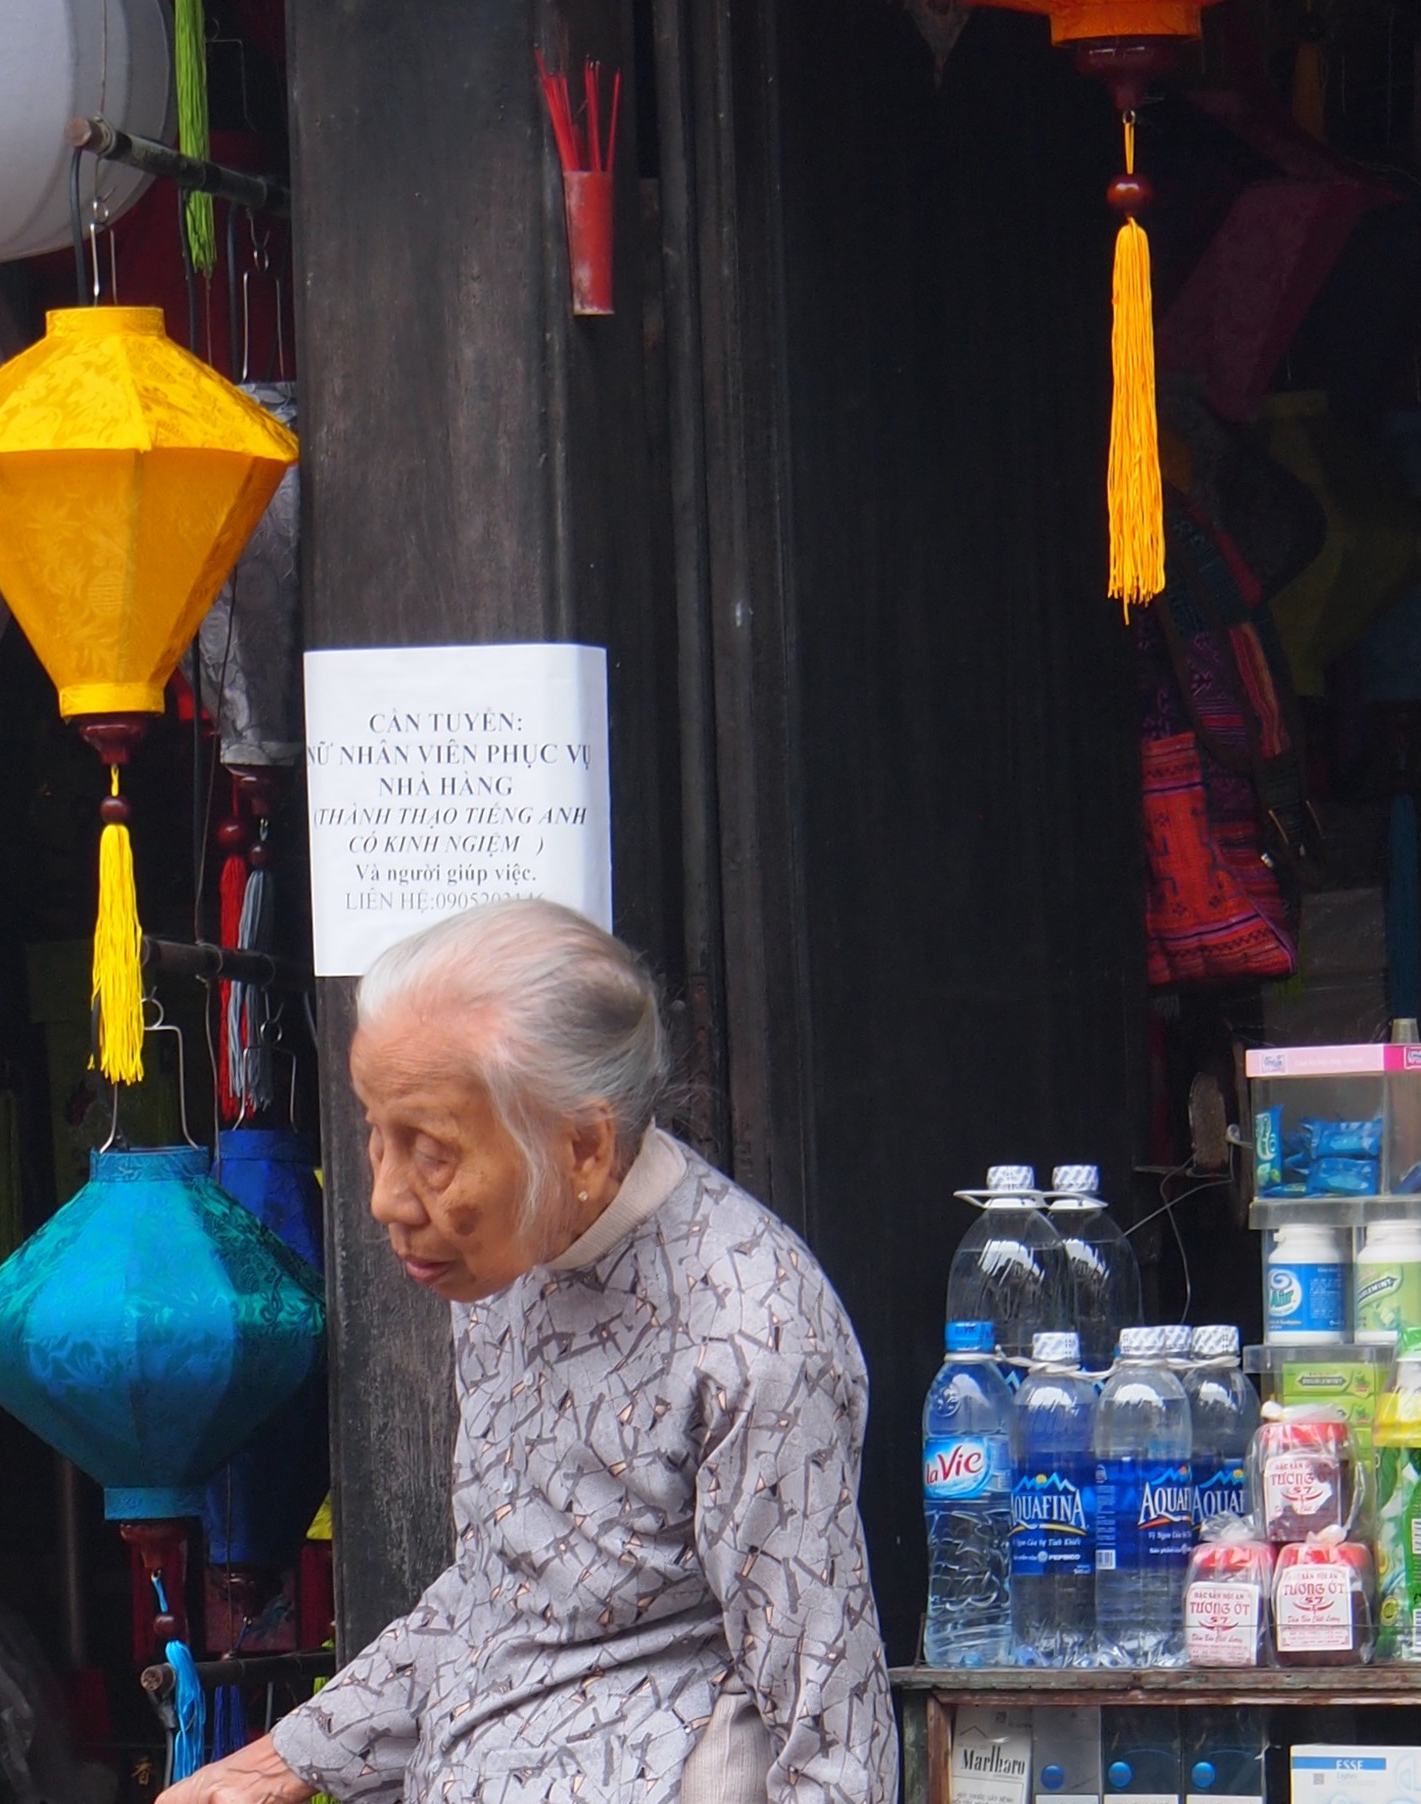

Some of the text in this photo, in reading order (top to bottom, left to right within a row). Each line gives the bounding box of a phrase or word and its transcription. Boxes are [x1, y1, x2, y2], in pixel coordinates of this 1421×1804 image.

[339, 738, 409, 765] NHÂN
[418, 738, 477, 764] VIÊN
[487, 743, 558, 769] PHỤC
[566, 743, 592, 771] VỤ
[379, 770, 513, 796] NHÀ HÀNG
[400, 807, 458, 829] THẠO
[466, 801, 534, 825] TIẾNG
[538, 807, 587, 825] ANH
[348, 830, 378, 854] CÓ
[384, 835, 440, 853] KINH
[445, 832, 521, 857] NGIỆM
[356, 862, 537, 886] Và người giúp việc.
[345, 887, 393, 910] LIÊN
[961, 1744, 1026, 1776] Marlboro
[1336, 1760, 1365, 1771] ESSE
